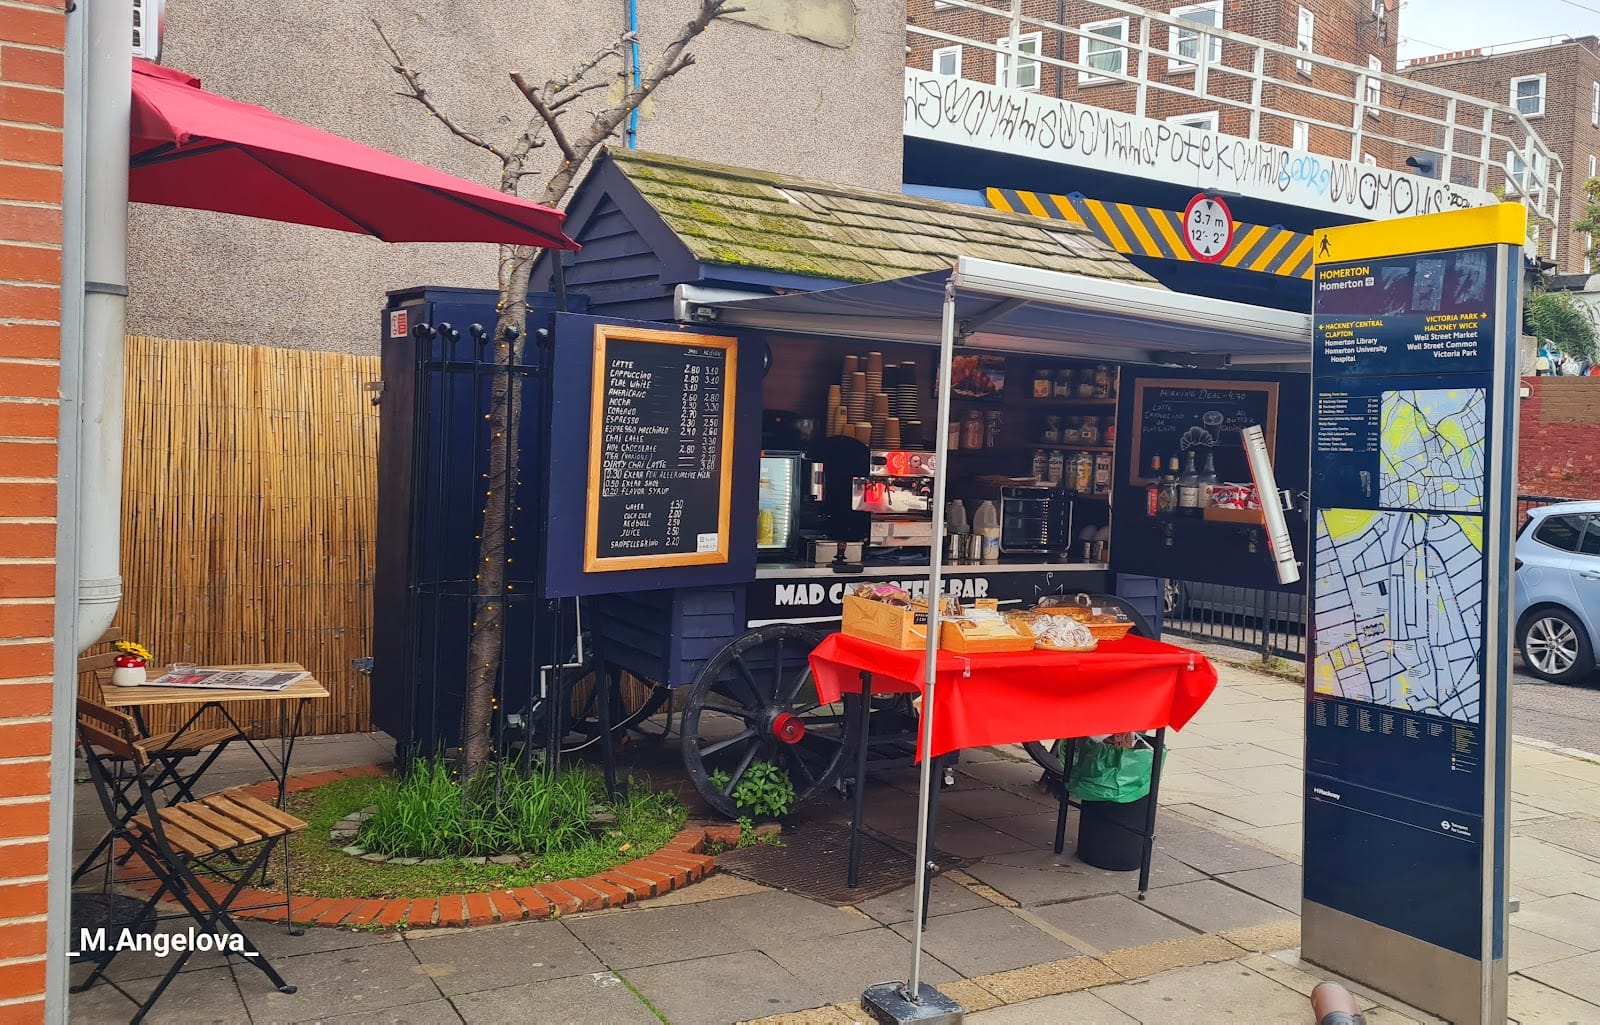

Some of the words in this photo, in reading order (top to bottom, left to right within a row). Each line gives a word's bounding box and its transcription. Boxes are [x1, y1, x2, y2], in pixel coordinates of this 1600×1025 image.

[1194, 209, 1211, 225] 3.7
[1214, 218, 1224, 228] m
[1319, 266, 1370, 280] HOMERTON
[1319, 279, 1364, 291] Homerton
[1426, 313, 1458, 323] VICTORIA
[1460, 312, 1479, 320] PARK
[1325, 321, 1355, 330] HACKNEY
[1355, 320, 1384, 328] CENTRAL
[1425, 323, 1457, 332] HACKNEY
[1459, 321, 1479, 330] WICK
[1325, 330, 1354, 338] CLAPTON
[1414, 333, 1430, 341] Well
[1430, 332, 1452, 341] Street
[1453, 330, 1478, 339] Market
[1325, 339, 1355, 347] Homerton
[1356, 337, 1378, 345] Library
[1423, 341, 1445, 350] Street
[1446, 340, 1478, 349] Common
[1325, 347, 1355, 355] Homerton
[1356, 345, 1388, 353] University
[1433, 349, 1461, 358] Victoria
[1461, 349, 1478, 357] Park
[1331, 354, 1356, 363] Hospital
[611, 359, 635, 369] LATTE
[605, 415, 640, 425] ESPRESSO
[775, 583, 825, 606] MAD
[954, 578, 989, 599] BAR
